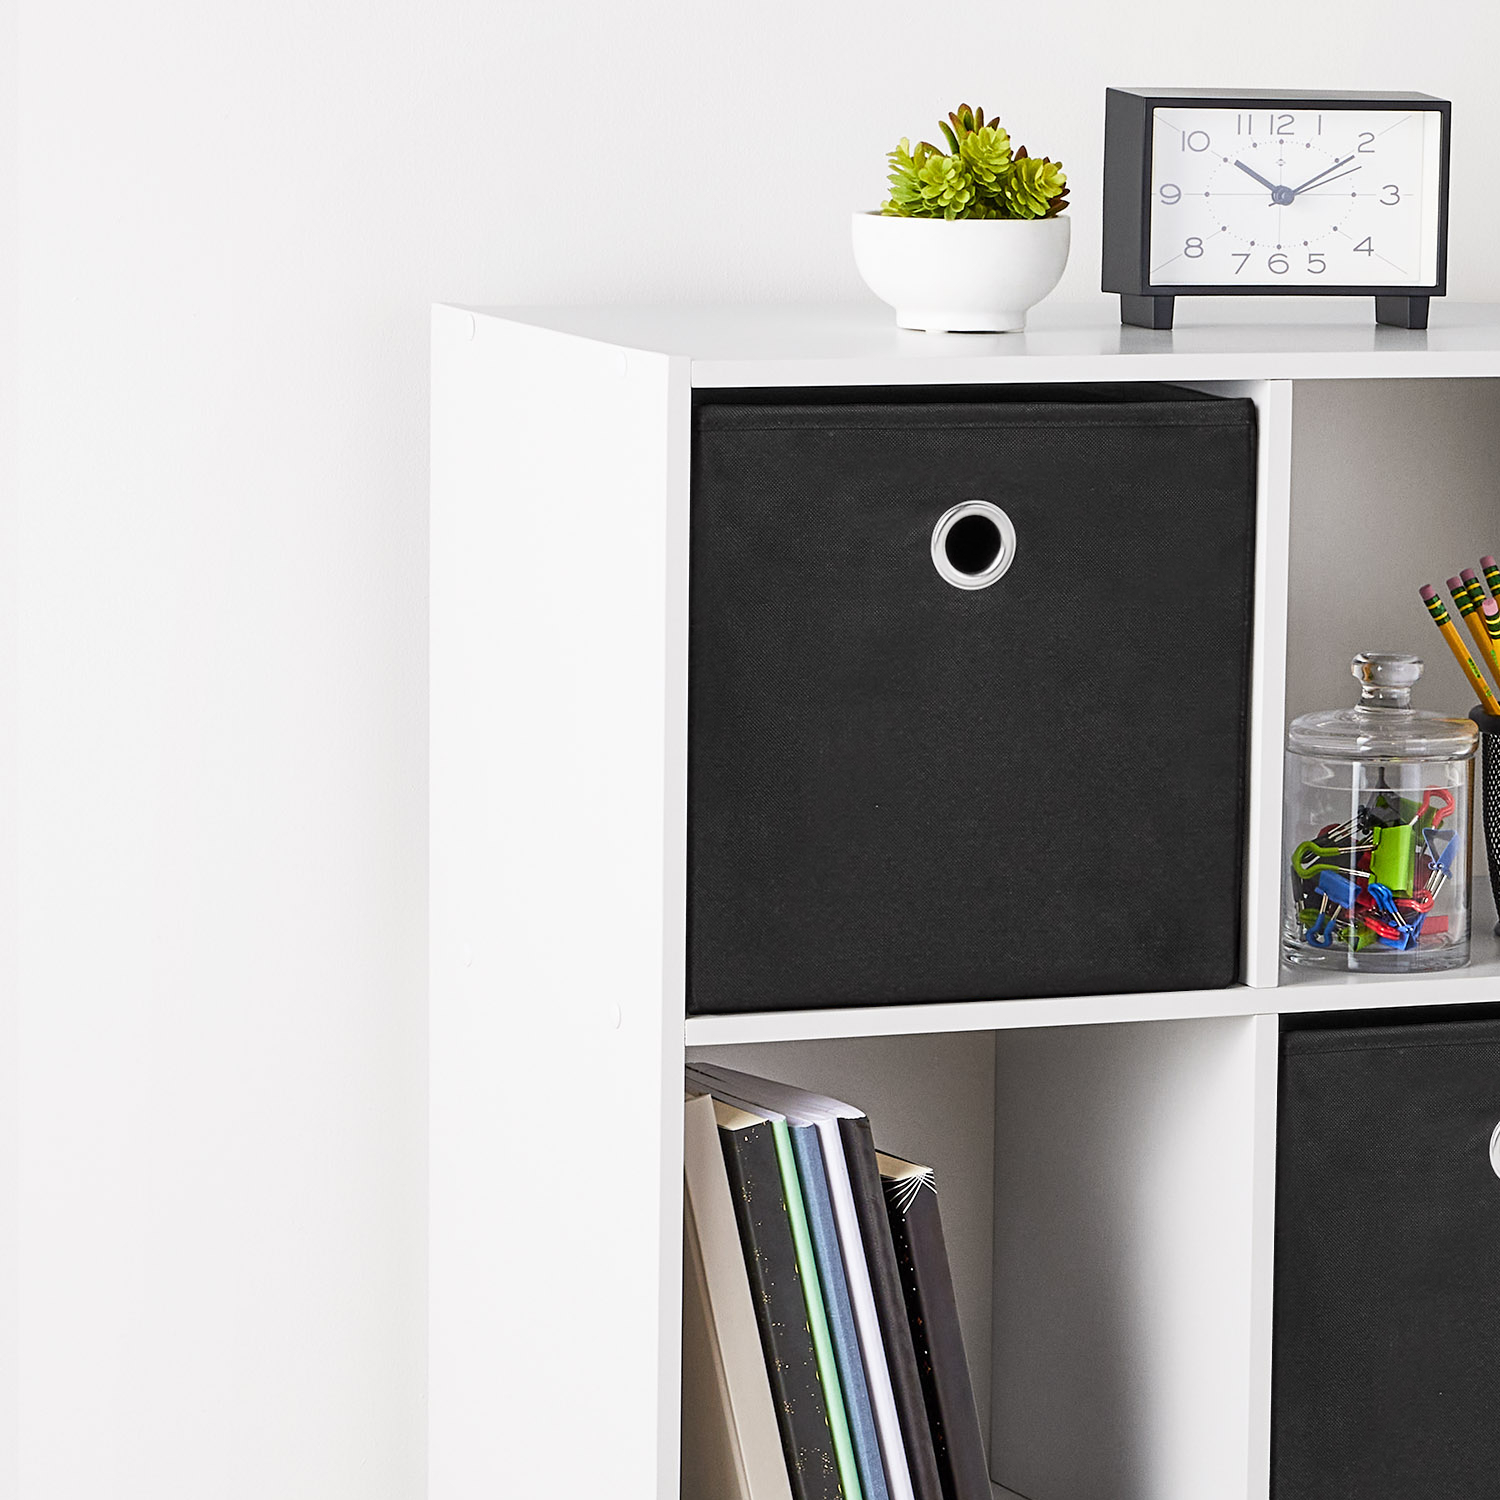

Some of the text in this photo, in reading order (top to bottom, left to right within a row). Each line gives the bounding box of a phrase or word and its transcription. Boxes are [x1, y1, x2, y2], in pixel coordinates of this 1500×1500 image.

[1237, 114, 1252, 135] 11
[1270, 114, 1295, 135] 12
[1181, 130, 1210, 152] 10
[1357, 132, 1375, 153] 2
[1159, 183, 1182, 205] 9
[1379, 184, 1400, 205] 3
[1184, 237, 1204, 258] 8
[1353, 236, 1374, 256] 4
[1231, 253, 1251, 274] 7
[1268, 253, 1289, 274] 6
[1307, 253, 1326, 274] 5
